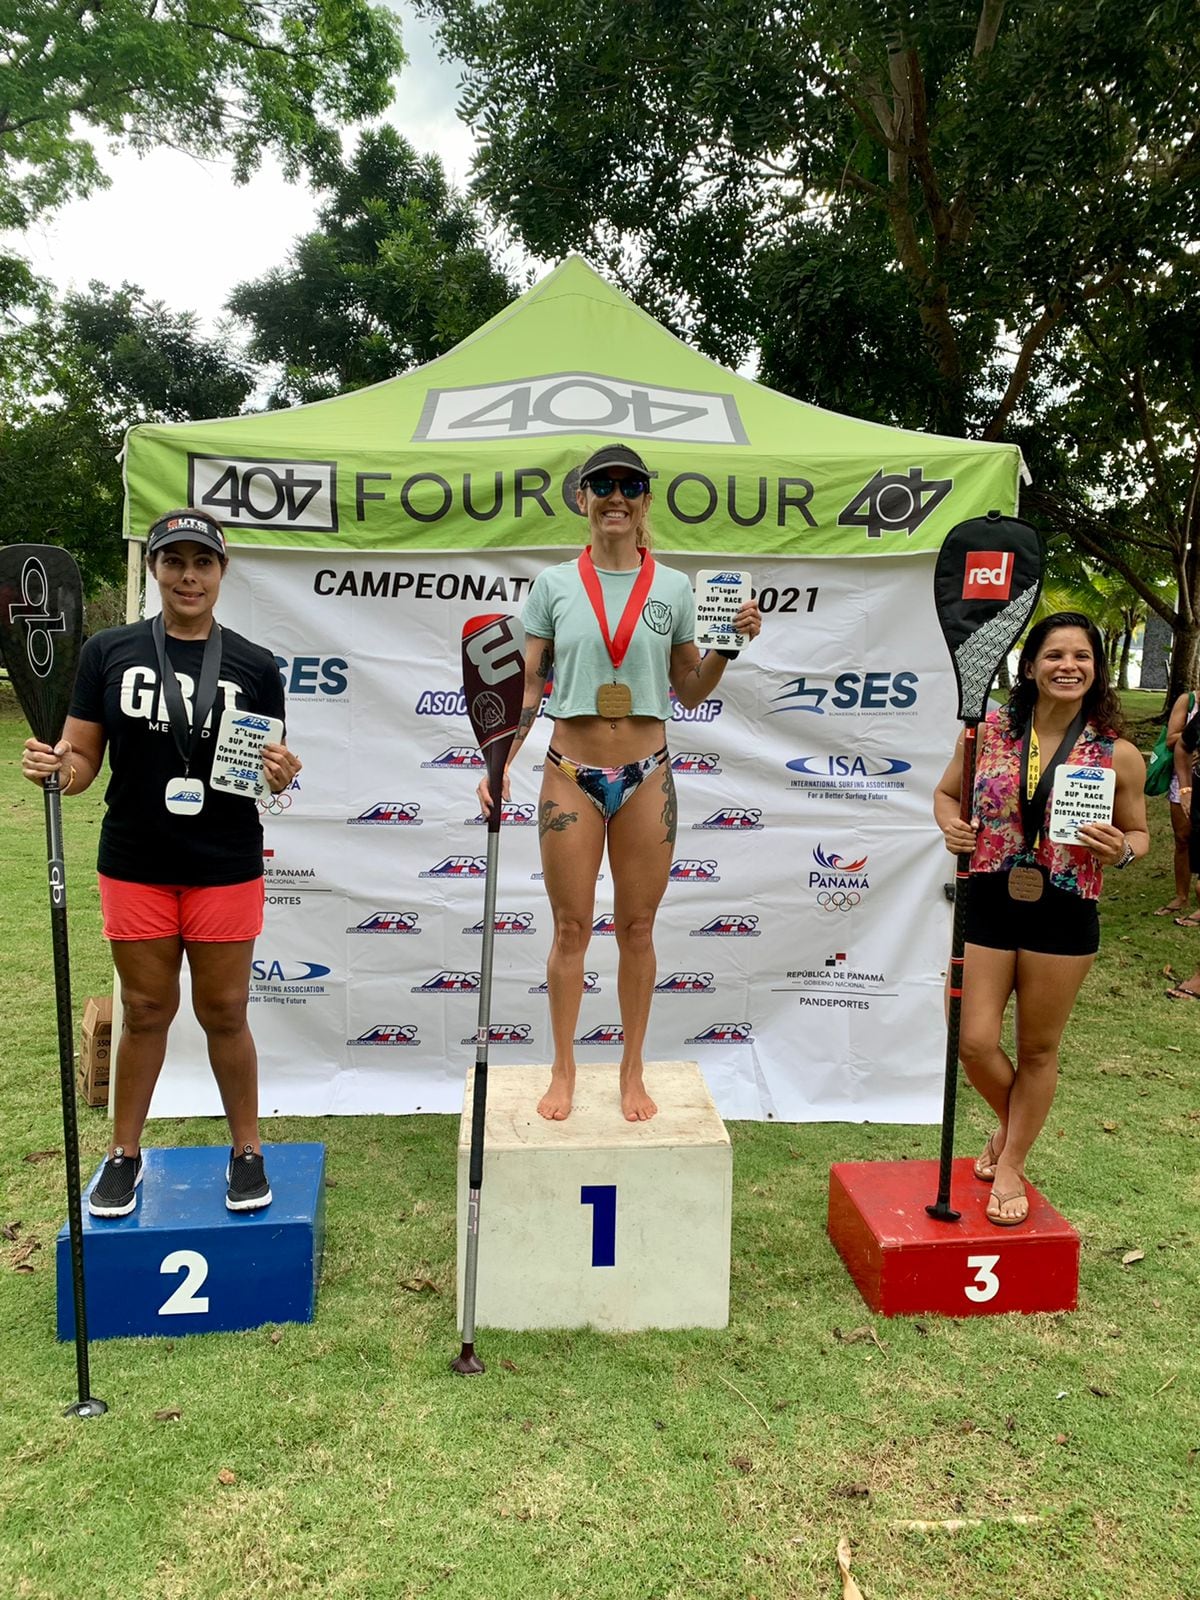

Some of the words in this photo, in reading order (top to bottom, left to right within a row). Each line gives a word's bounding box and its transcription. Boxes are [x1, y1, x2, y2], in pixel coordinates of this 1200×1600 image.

[356, 469, 555, 522] FOUR
[648, 467, 819, 527] OUR
[968, 552, 1009, 586] red
[314, 569, 536, 602] CAMPEONAT
[698, 605, 715, 613] Open
[697, 614, 731, 622] DISTANCE
[831, 671, 919, 709] SES
[228, 737, 243, 745] SUP
[248, 740, 264, 749] RAC
[219, 745, 237, 754] Open
[240, 749, 262, 760] Femen
[216, 755, 253, 768] DISTANCE
[829, 755, 867, 776] ISA
[791, 780, 837, 788] INTERNATIONAL
[866, 781, 905, 789] ASSOCIATION
[825, 792, 844, 800] Better
[845, 793, 867, 801] Surfing
[357, 802, 420, 820] APS
[1054, 809, 1091, 818] DISTANCE
[1076, 801, 1111, 810] Femenino
[703, 808, 762, 826] APS
[276, 868, 316, 877] PANAMÁ
[809, 871, 869, 889] PANAMÁ
[357, 912, 418, 929] APS
[700, 915, 759, 932] APS
[252, 960, 285, 981] SA
[786, 969, 831, 979] REPÚBLICA
[833, 971, 845, 980] DE
[847, 970, 885, 982] PANAMÁ
[255, 984, 282, 993] SURFING
[655, 972, 714, 989] APS
[835, 981, 866, 989] NACIONAL
[263, 996, 285, 1004] Surfing
[800, 997, 870, 1010] PANDEPORTES
[356, 1025, 417, 1041] APS
[694, 1022, 752, 1040] APS
[580, 1185, 617, 1267] 1
[158, 1250, 209, 1315] 2
[964, 1255, 1000, 1303] 3
